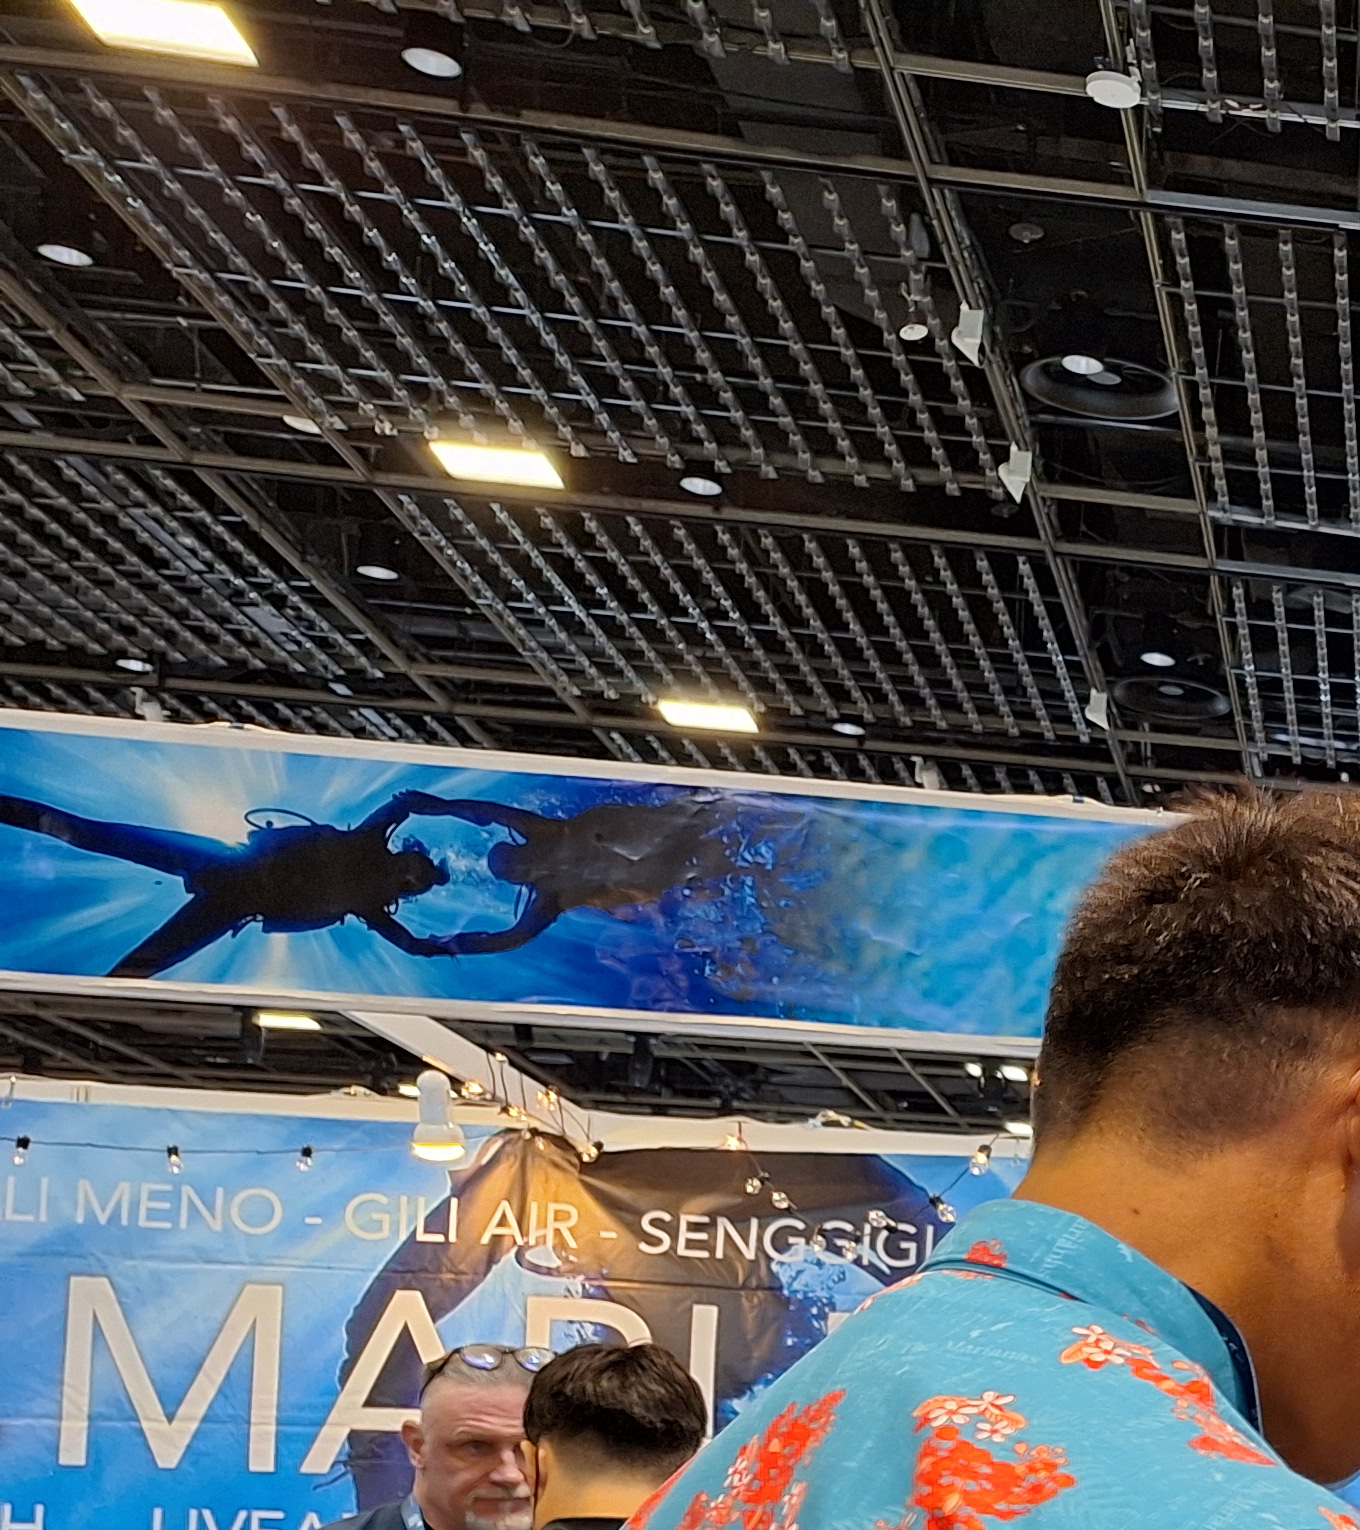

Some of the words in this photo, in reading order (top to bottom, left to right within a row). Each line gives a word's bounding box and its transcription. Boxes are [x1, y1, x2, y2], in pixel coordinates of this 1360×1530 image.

[75, 1179, 283, 1235] MENO
[344, 1192, 458, 1243] GILI
[480, 1200, 579, 1249] AIR
